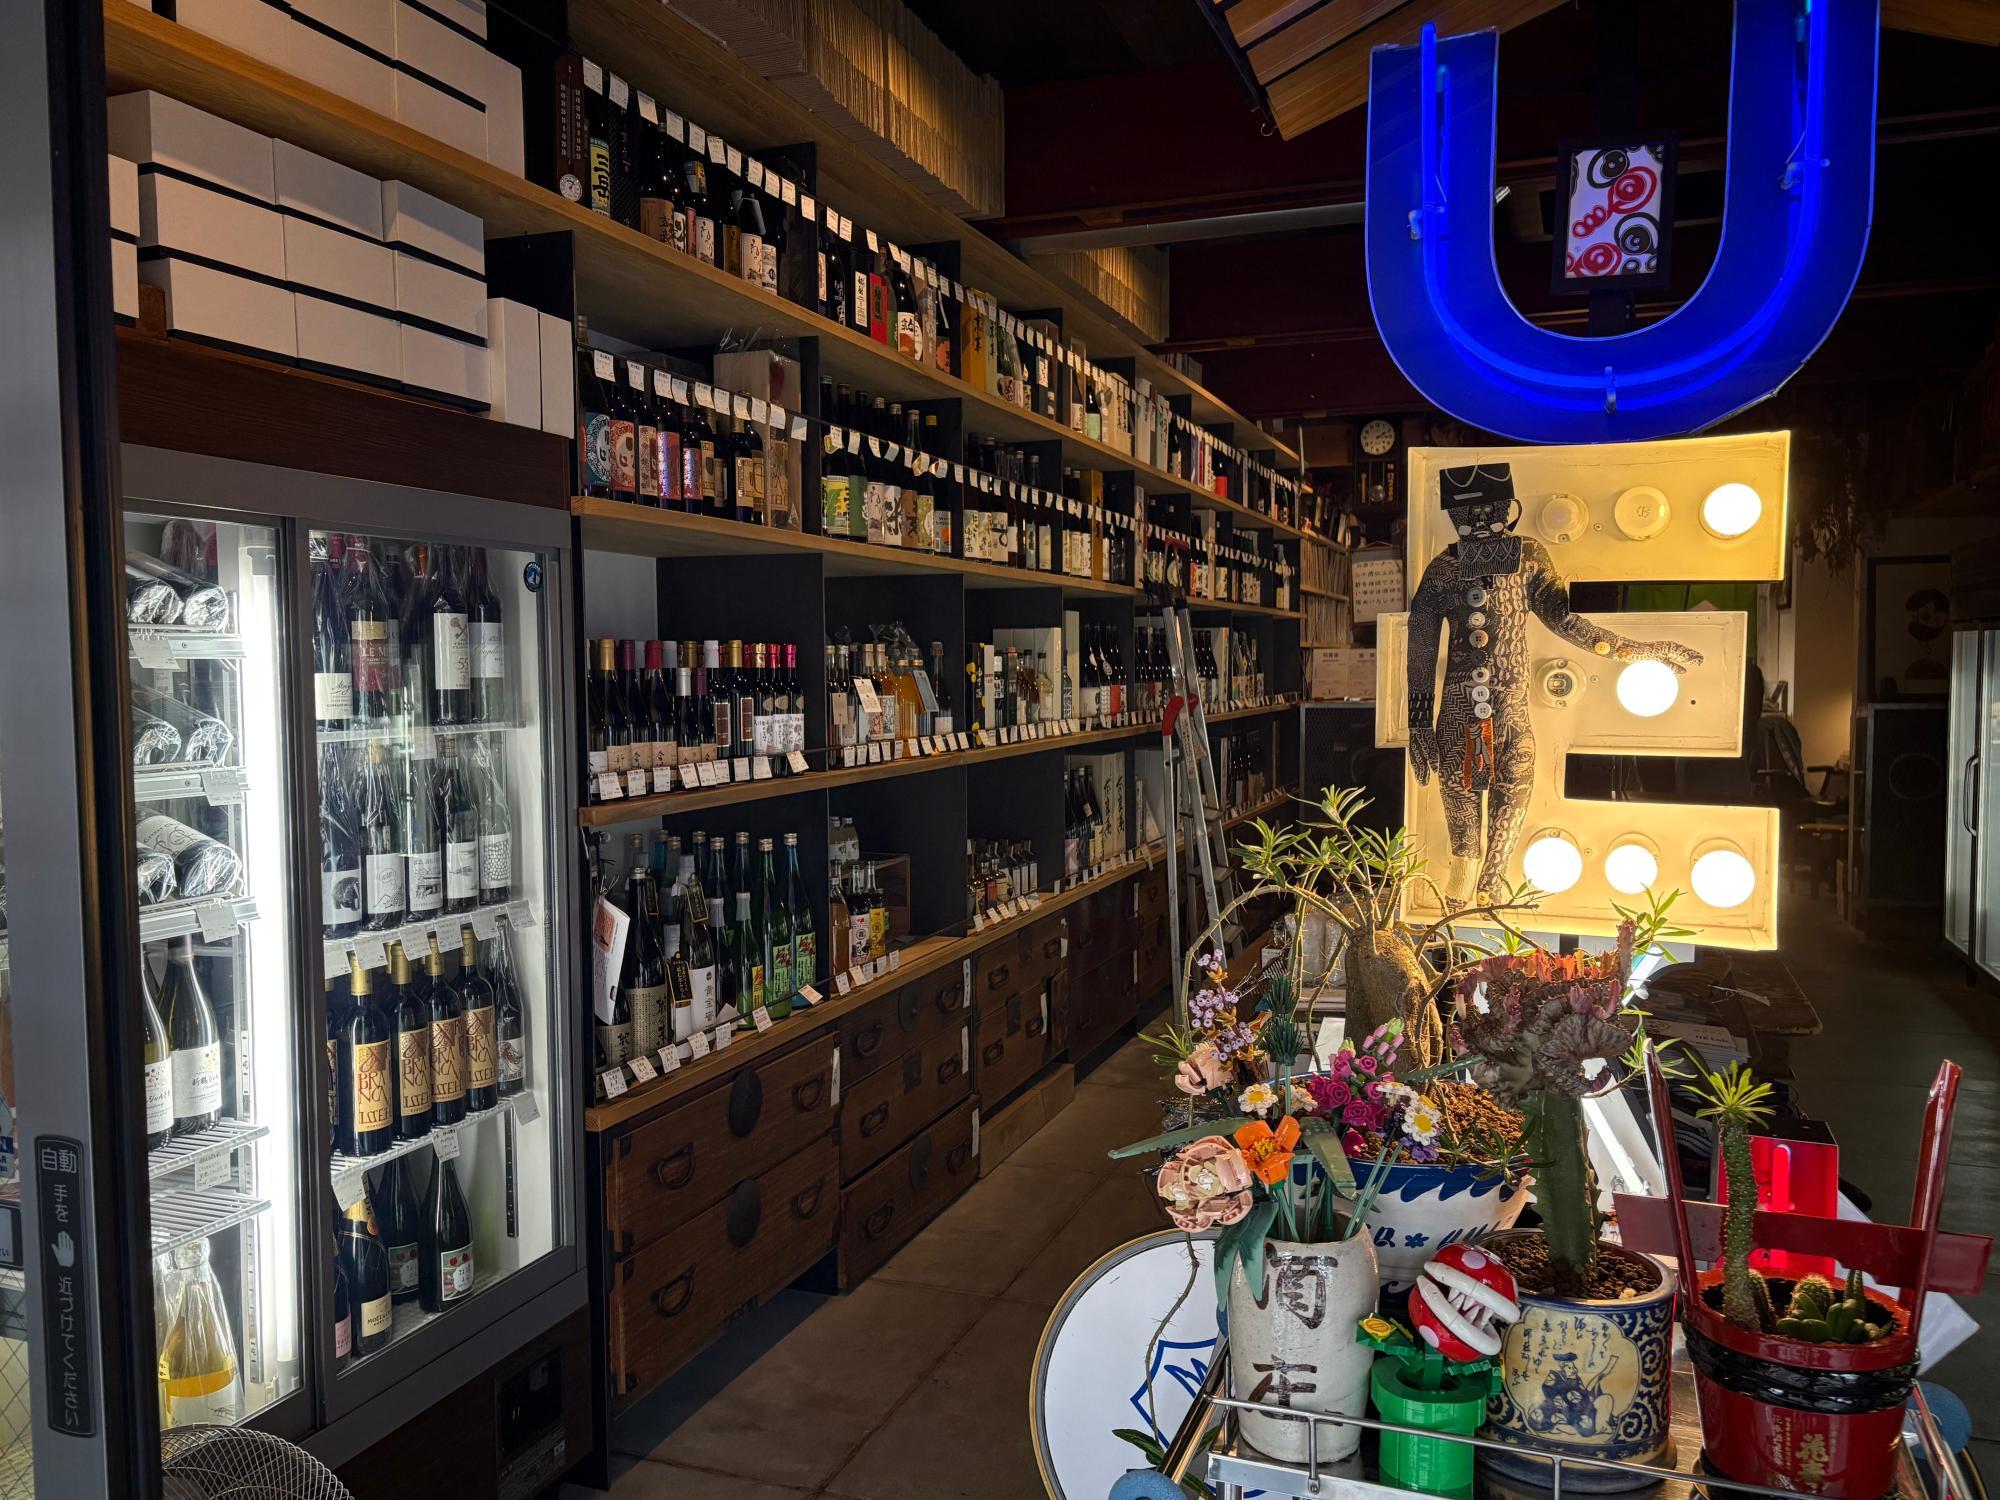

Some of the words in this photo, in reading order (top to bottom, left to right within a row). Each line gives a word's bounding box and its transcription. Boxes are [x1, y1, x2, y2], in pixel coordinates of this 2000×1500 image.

[1368, 0, 1880, 443] U
[1375, 429, 1792, 952] E
[41, 1146, 77, 1174] 自動
[53, 1183, 69, 1223] 手を
[58, 1274, 82, 1427] 近づけてください
